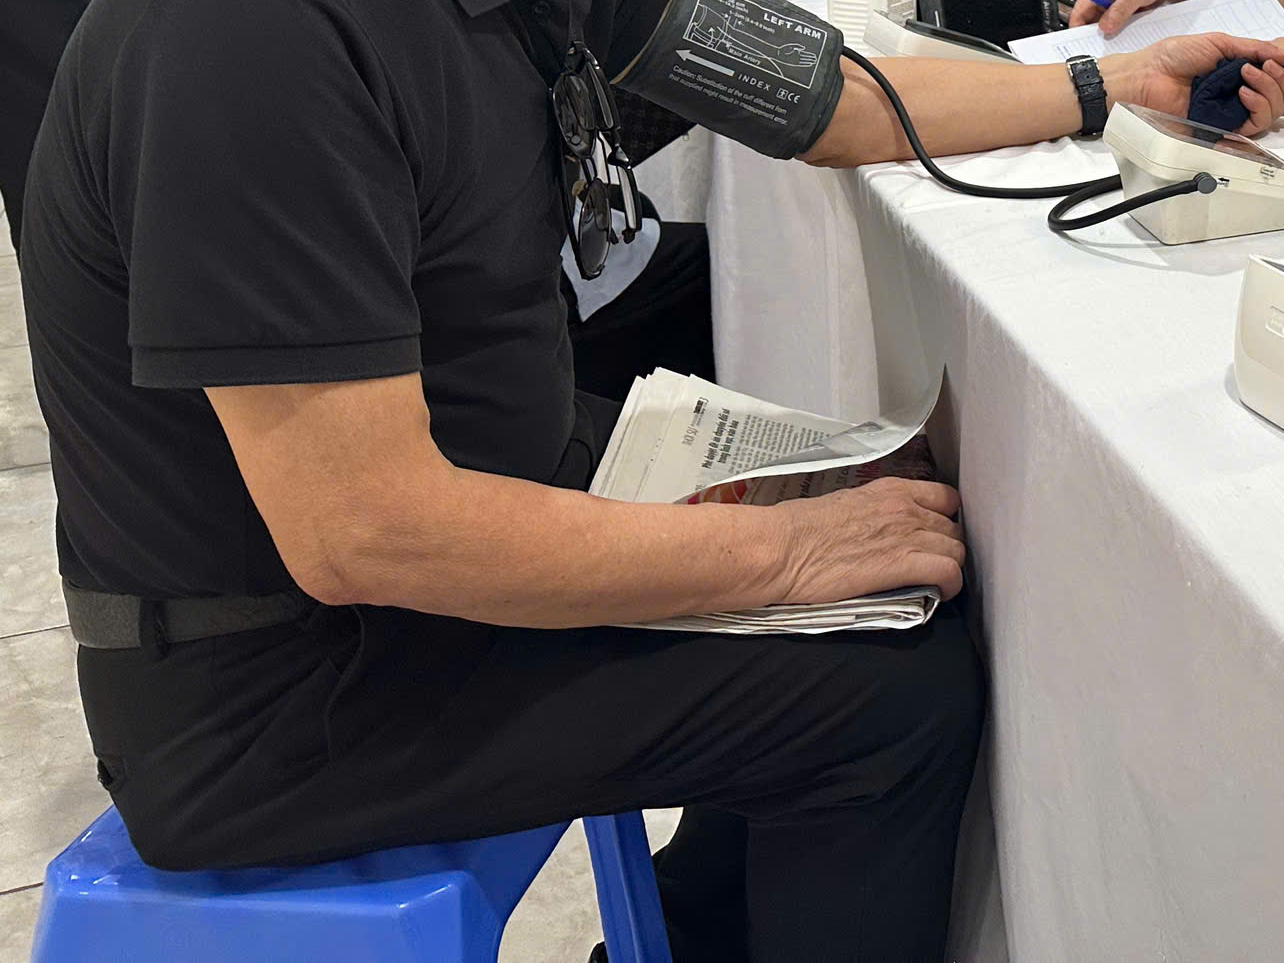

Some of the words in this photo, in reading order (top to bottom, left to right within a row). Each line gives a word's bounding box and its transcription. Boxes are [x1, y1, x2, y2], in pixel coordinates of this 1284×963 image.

[762, 11, 793, 30] LEFT
[794, 23, 822, 40] ARM
[672, 65, 696, 79] Caution:
[695, 74, 728, 91] Substitution
[727, 86, 735, 94] of
[733, 89, 743, 97] the
[742, 93, 752, 101] cuff
[751, 96, 775, 110] different
[774, 105, 787, 115] from
[737, 72, 771, 91] INDEX
[701, 86, 719, 99] might
[718, 92, 734, 103] result
[738, 100, 775, 119] measurement
